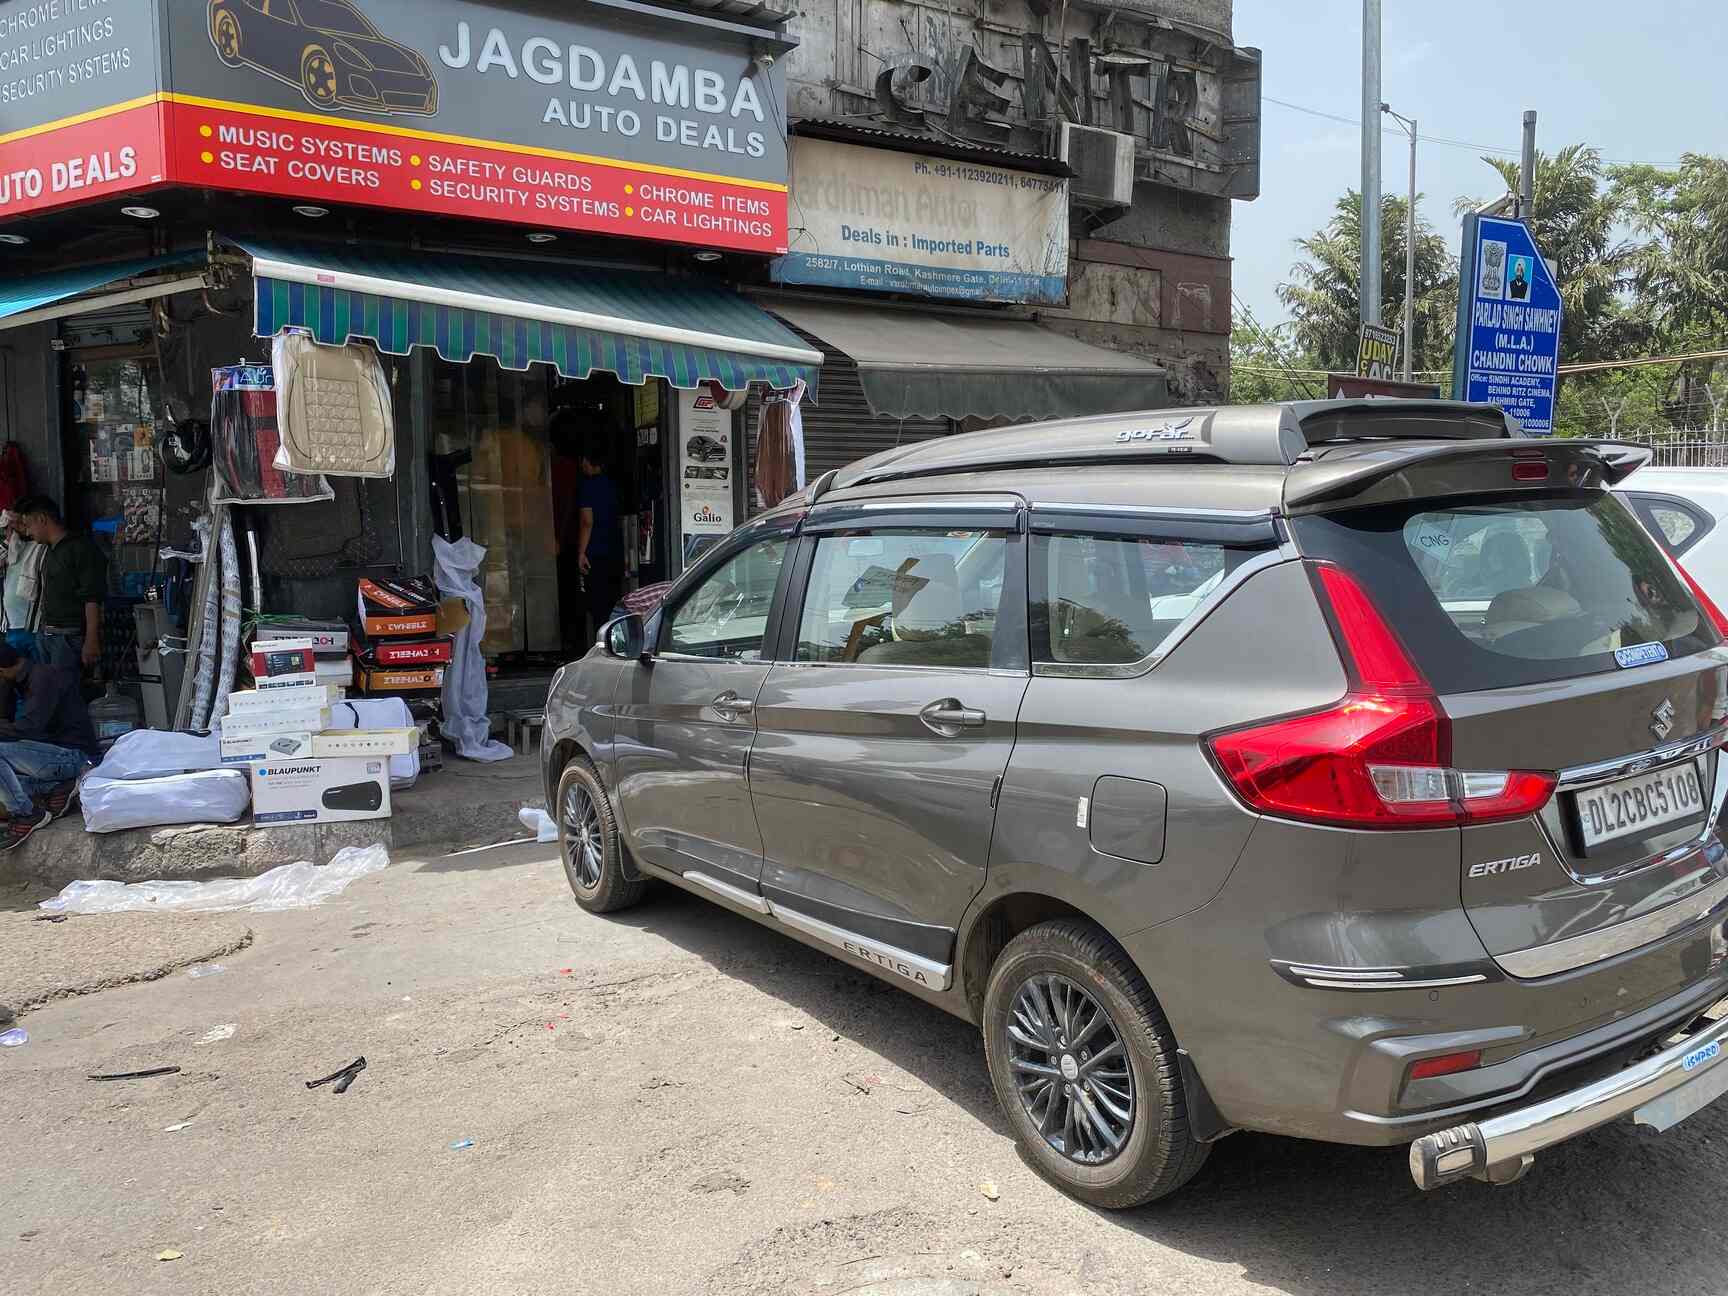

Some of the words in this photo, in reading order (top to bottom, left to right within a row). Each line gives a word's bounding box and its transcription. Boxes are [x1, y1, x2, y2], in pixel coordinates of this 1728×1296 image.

[0, 1, 58, 38] CHROME
[0, 45, 29, 70] CAR
[32, 16, 113, 60] LIGHTINGS
[2, 68, 64, 103] SECURITY
[68, 47, 130, 83] SYSTEMS
[438, 21, 765, 122] JAGDAMBA
[542, 98, 642, 137] AUTO
[656, 114, 765, 159] DEALS
[218, 125, 295, 151] MUSIC
[301, 137, 403, 167] SYSTEMS
[51, 146, 137, 192] DEALS
[220, 151, 279, 175] SEAT
[288, 160, 380, 188] COVERS
[428, 155, 506, 180] SAFETY
[512, 167, 592, 192] GUARDS
[914, 161, 931, 176] Ph.
[430, 179, 529, 206] SECURITY
[535, 193, 620, 218] SYSTEMS
[639, 184, 714, 208] CHROME
[721, 195, 770, 216] ITEMS
[640, 206, 677, 225] CAR
[683, 212, 772, 237] LIGHTINGS
[841, 224, 882, 245] Deals
[886, 231, 899, 247] in
[911, 236, 972, 256] Imported
[976, 240, 1010, 257] Parts
[1475, 301, 1501, 328] PARLAD
[1502, 304, 1524, 331] SINGH
[1525, 307, 1558, 334] SAWHNEY
[1362, 338, 1394, 364] UDAY
[1495, 331, 1534, 352] (M.L.A.)
[1473, 350, 1516, 370] CHANDNI
[1518, 354, 1552, 373] CHOWK
[1488, 374, 1509, 384] SINDHI
[1488, 385, 1511, 395] BEHIND
[1420, 534, 1449, 549] CNG
[268, 765, 321, 776] BLAUPUNKT
[1588, 772, 1699, 836] DL2CBC5108
[1468, 852, 1541, 878] ERTIGA
[842, 941, 928, 985] ERTIGA
